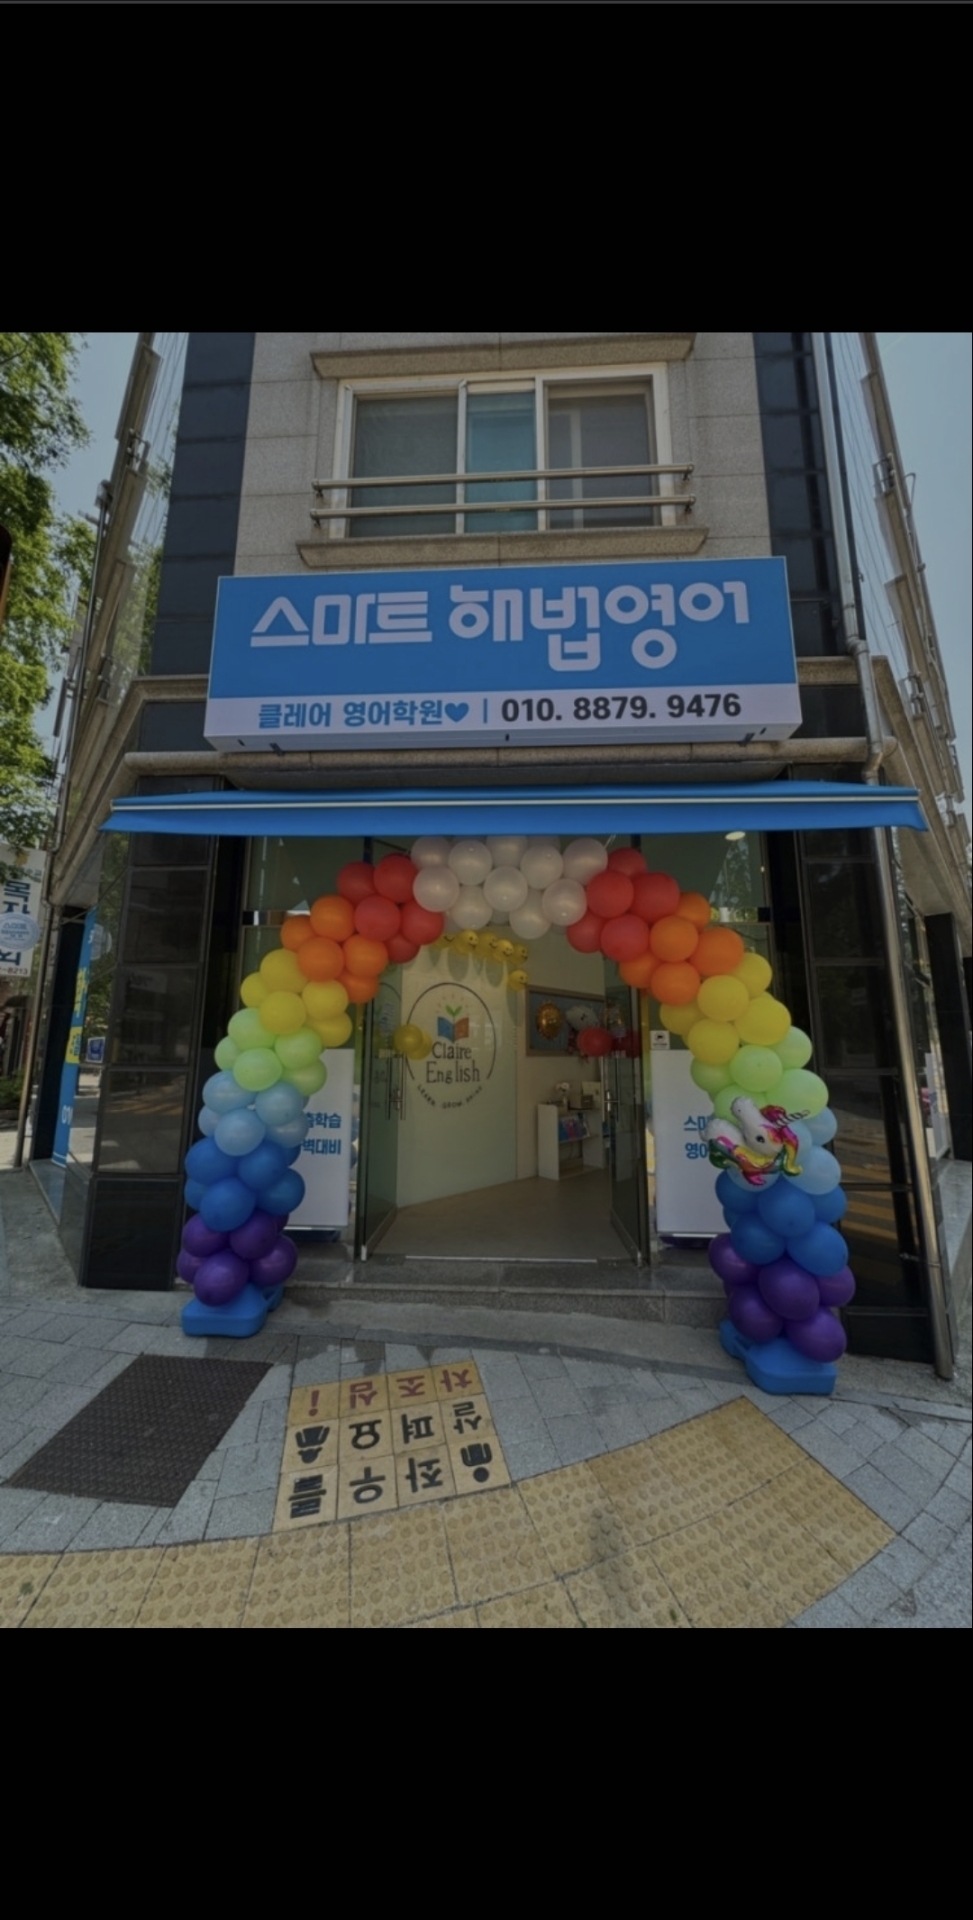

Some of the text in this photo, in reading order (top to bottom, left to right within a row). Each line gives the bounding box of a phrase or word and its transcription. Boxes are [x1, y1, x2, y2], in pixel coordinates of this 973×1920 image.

[250, 581, 750, 671] 스마트 해법영어
[258, 692, 741, 729] 클레어 영어학원 010. 8879. 9476
[431, 1041, 472, 1060] Claire
[426, 1060, 481, 1084] English
[301, 1138, 341, 1155] 벽대비
[309, 1368, 473, 1416] 차조심!
[349, 1401, 482, 1450] 살펴요
